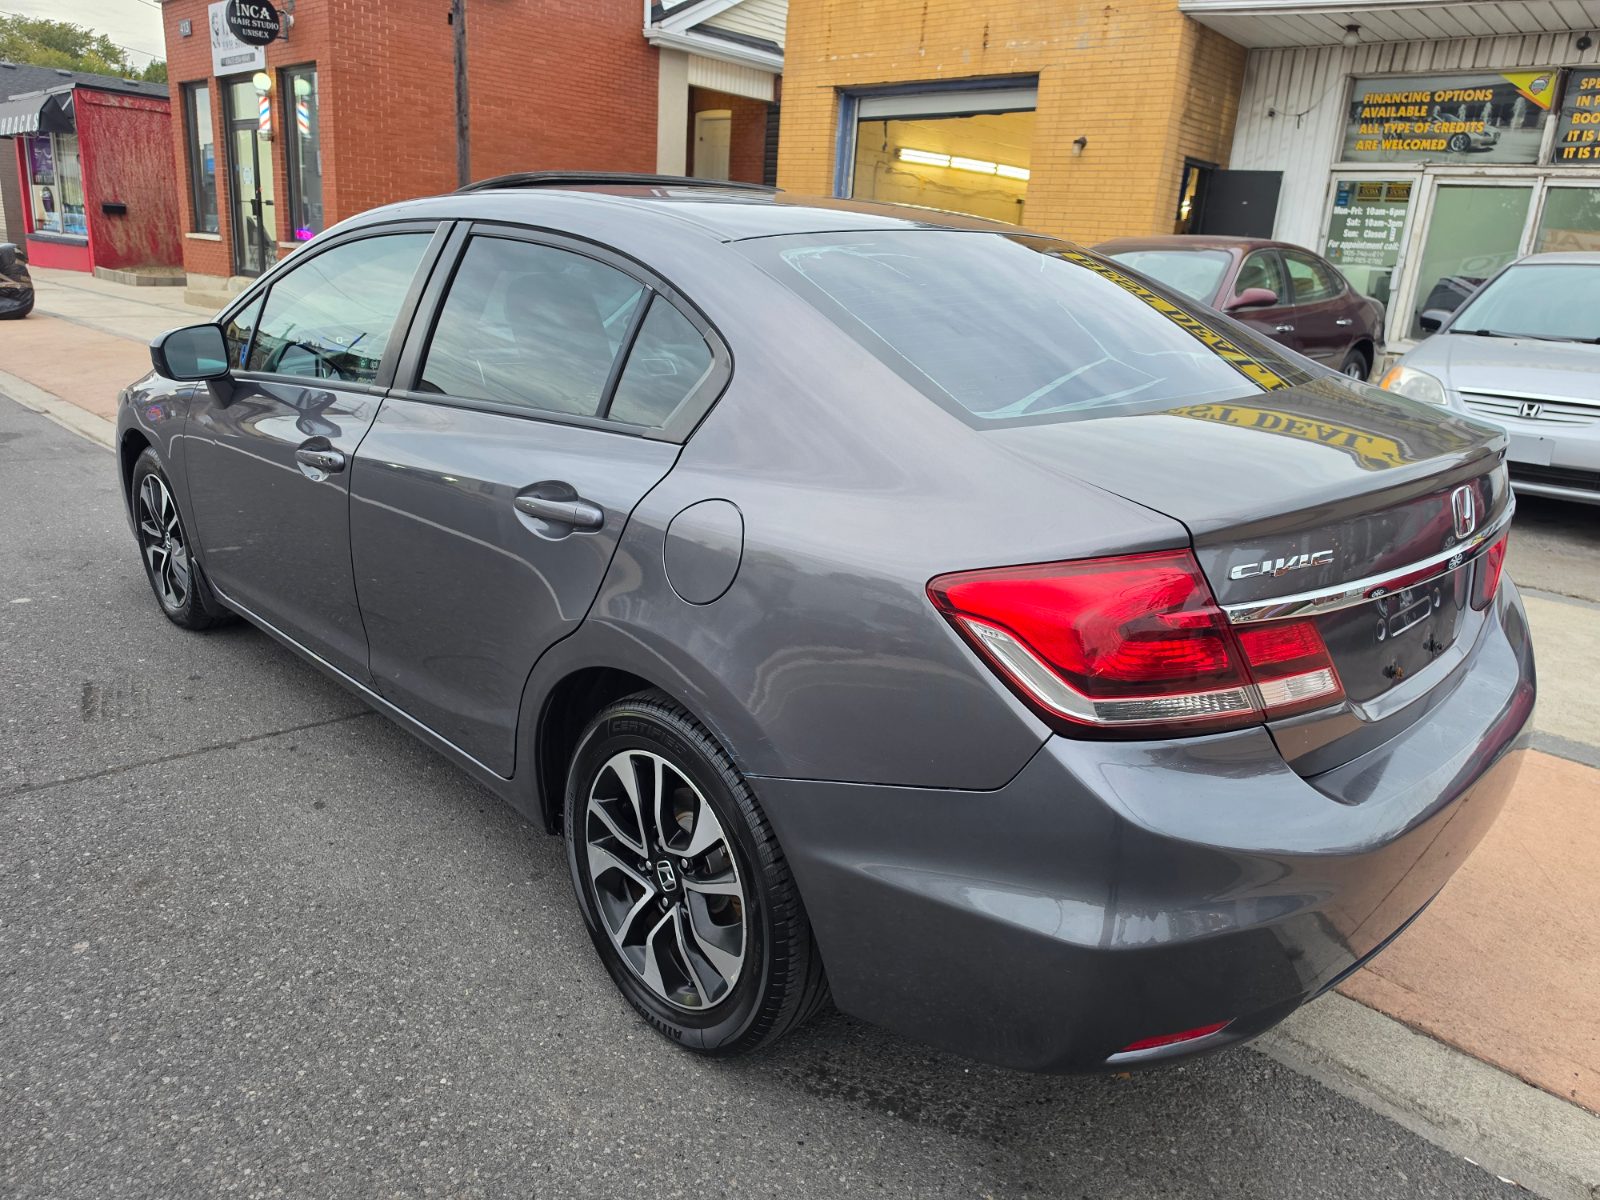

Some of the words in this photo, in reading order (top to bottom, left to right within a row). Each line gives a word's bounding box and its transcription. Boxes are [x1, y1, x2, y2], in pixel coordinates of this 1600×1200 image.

[235, 0, 272, 20] INCA
[231, 16, 251, 26] HAIR
[252, 19, 279, 31] STUDIO
[242, 28, 269, 39] UNISEX
[1363, 91, 1431, 104] FINANCING
[1433, 88, 1493, 103] OPTIONS
[1576, 95, 1591, 107] IN
[1361, 105, 1428, 118] AVAILABLE
[1359, 123, 1380, 134] ALL
[1383, 122, 1410, 134] TYPE
[1413, 122, 1432, 133] OF
[1433, 121, 1485, 133] CREDITS
[1567, 129, 1580, 142] IT
[1582, 129, 1595, 142] IS
[1355, 140, 1379, 151] ARE
[1381, 139, 1447, 151] WELCOMED
[1563, 147, 1576, 158] IT
[1577, 147, 1591, 158] IS
[1333, 205, 1363, 215] Mon-Fri:
[1366, 206, 1406, 217] 10am-6pm
[1346, 217, 1361, 227] Sat:
[1343, 229, 1359, 238] Sun:
[1363, 229, 1387, 239] Closed
[1328, 239, 1340, 248] For
[1340, 241, 1384, 250] appointment
[1384, 241, 1399, 250] call:
[1229, 549, 1335, 581] CIVIC
